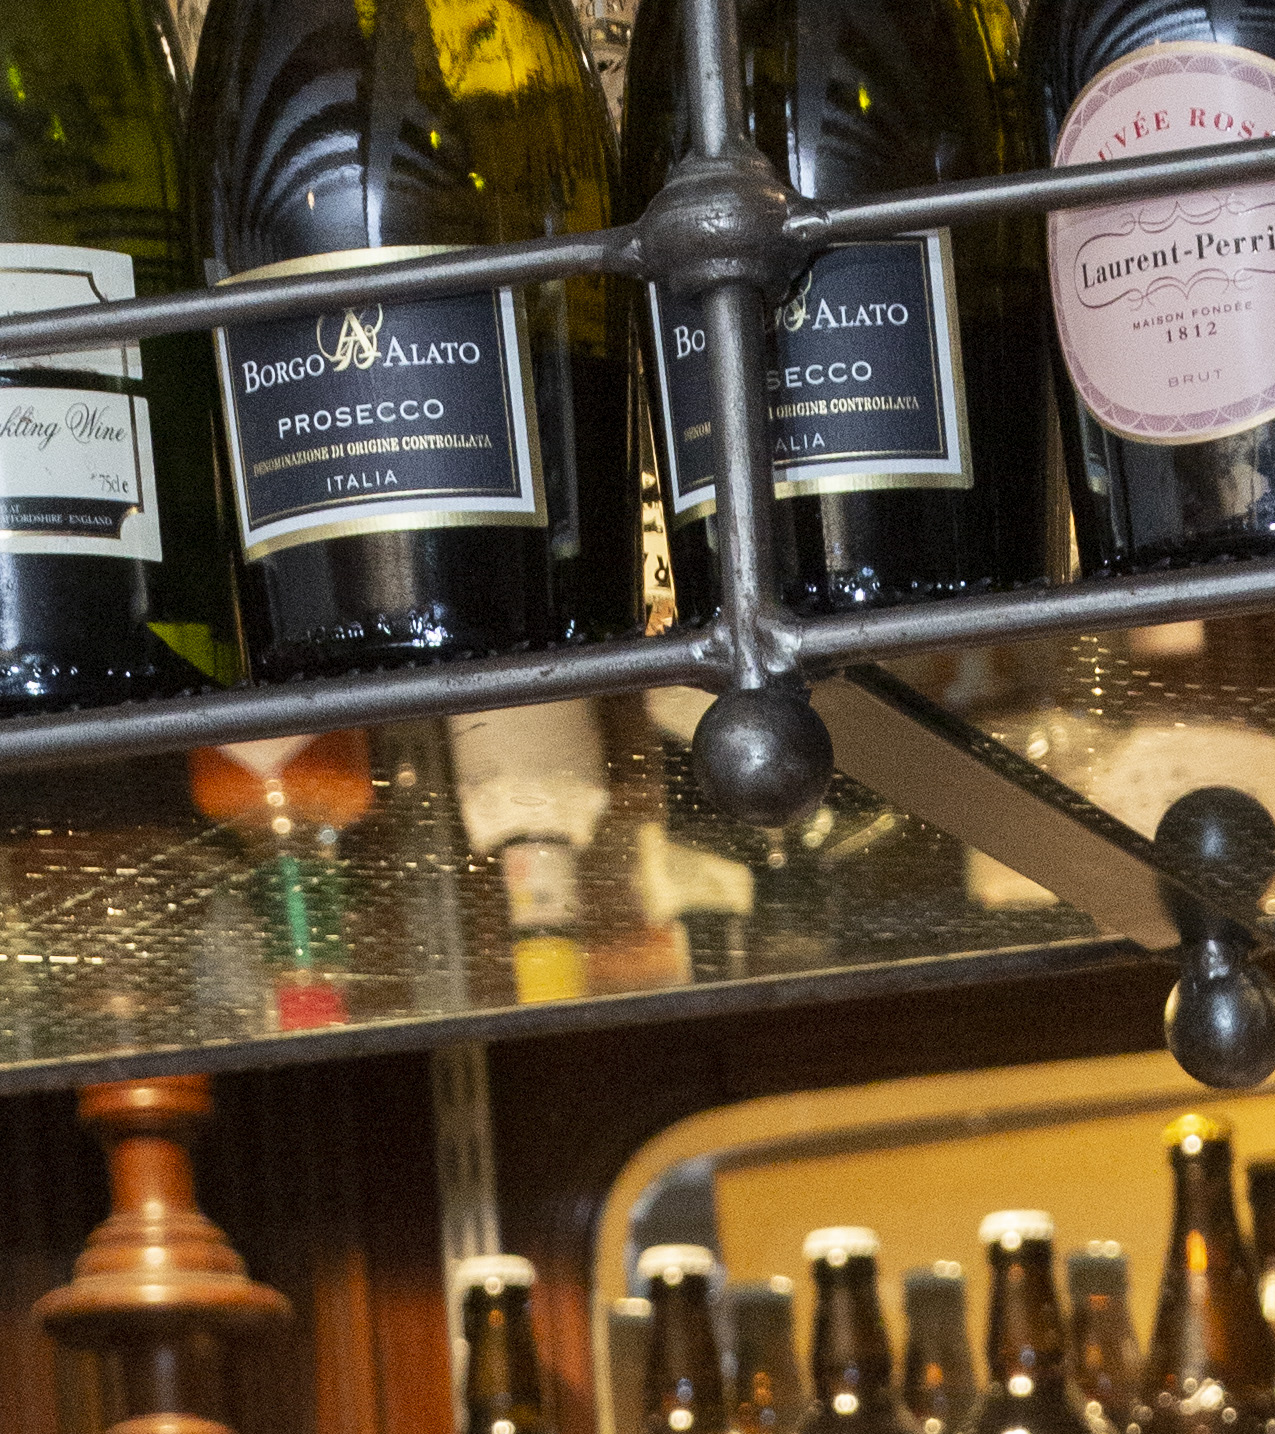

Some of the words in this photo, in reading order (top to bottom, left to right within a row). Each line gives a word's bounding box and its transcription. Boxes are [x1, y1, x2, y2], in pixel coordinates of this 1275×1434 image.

[1097, 108, 1171, 163] UVÉE
[812, 299, 909, 330] ALATO
[1132, 311, 1185, 332] MAISON
[1165, 321, 1218, 343] 1812
[242, 354, 325, 394] BORGO
[384, 336, 480, 368] ALATO
[1167, 368, 1224, 388] BRUT
[65, 402, 126, 445] Wine
[278, 399, 444, 439] PROSECCO
[776, 400, 828, 419] ORIGINE
[830, 397, 920, 412] CONTROLLATA
[254, 446, 330, 478] DENOMINAZIONE
[332, 446, 344, 459] DI
[347, 437, 399, 456] ORIGINE
[402, 434, 492, 450] CONTROLLATA
[326, 469, 398, 493] ITALIA
